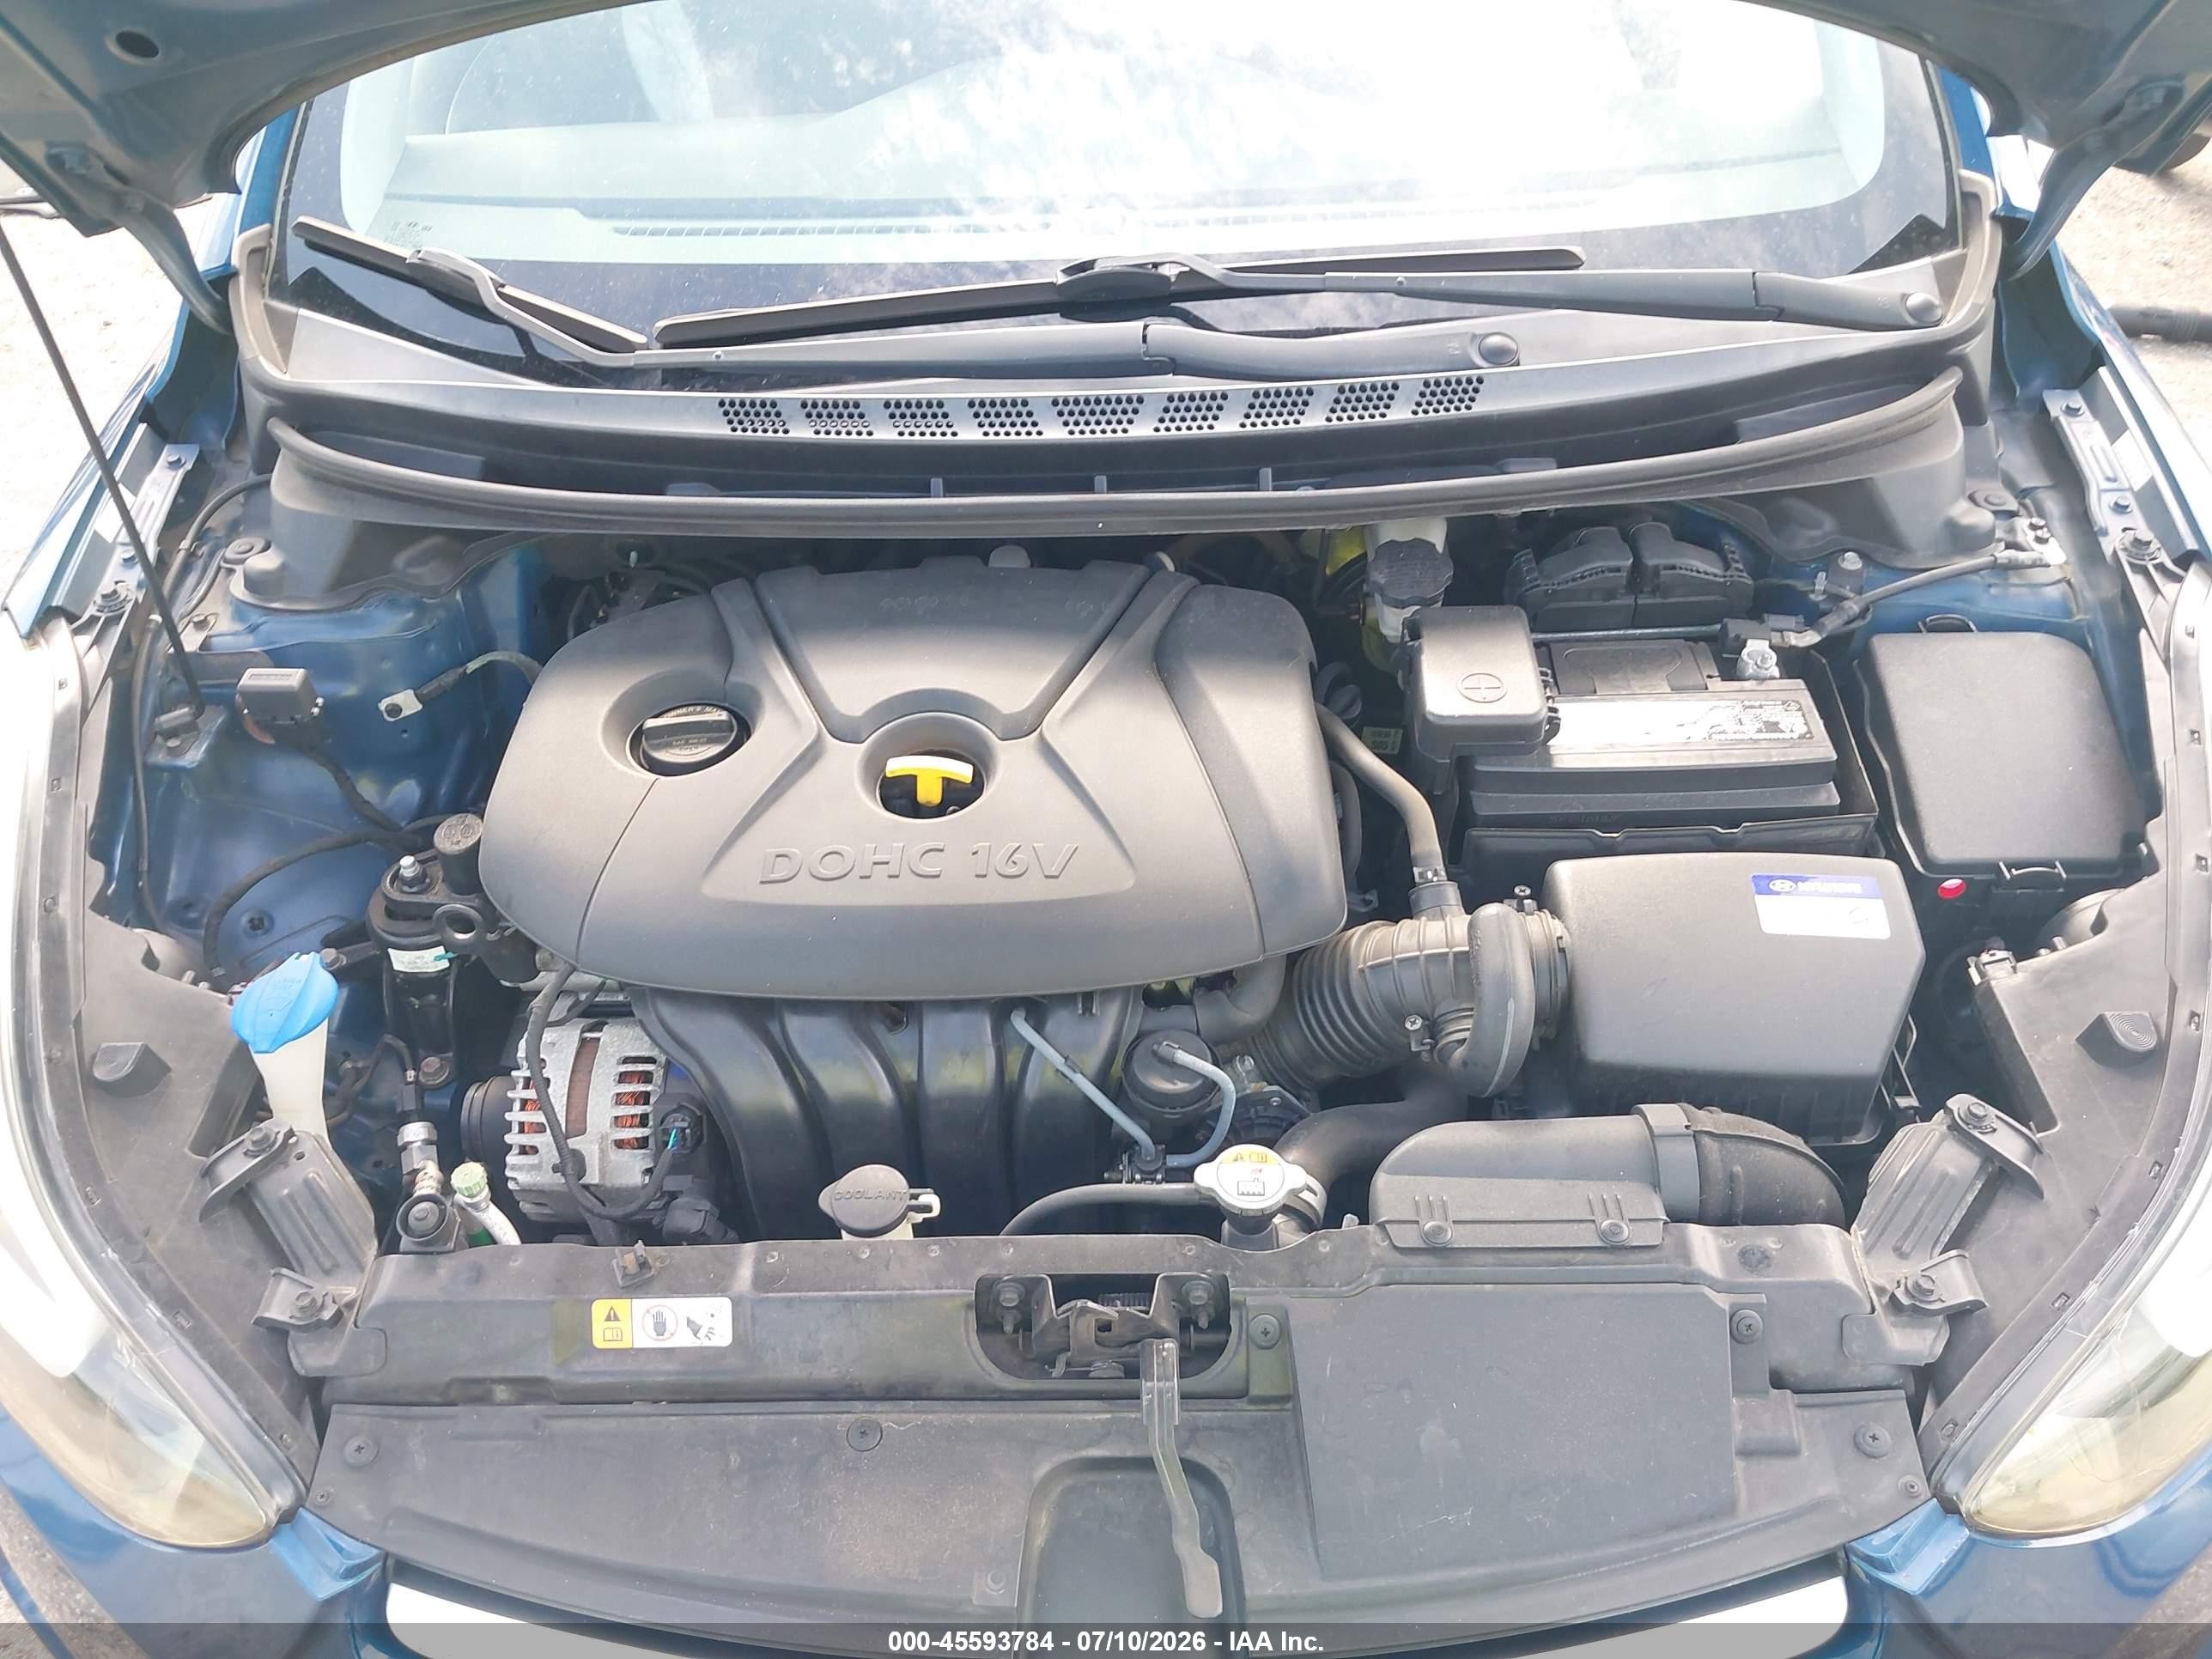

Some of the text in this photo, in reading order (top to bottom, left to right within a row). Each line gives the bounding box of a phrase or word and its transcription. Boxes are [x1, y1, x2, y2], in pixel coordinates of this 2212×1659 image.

[759, 842, 1079, 884] DOHC 16V
[834, 1188, 908, 1201] COOLANT
